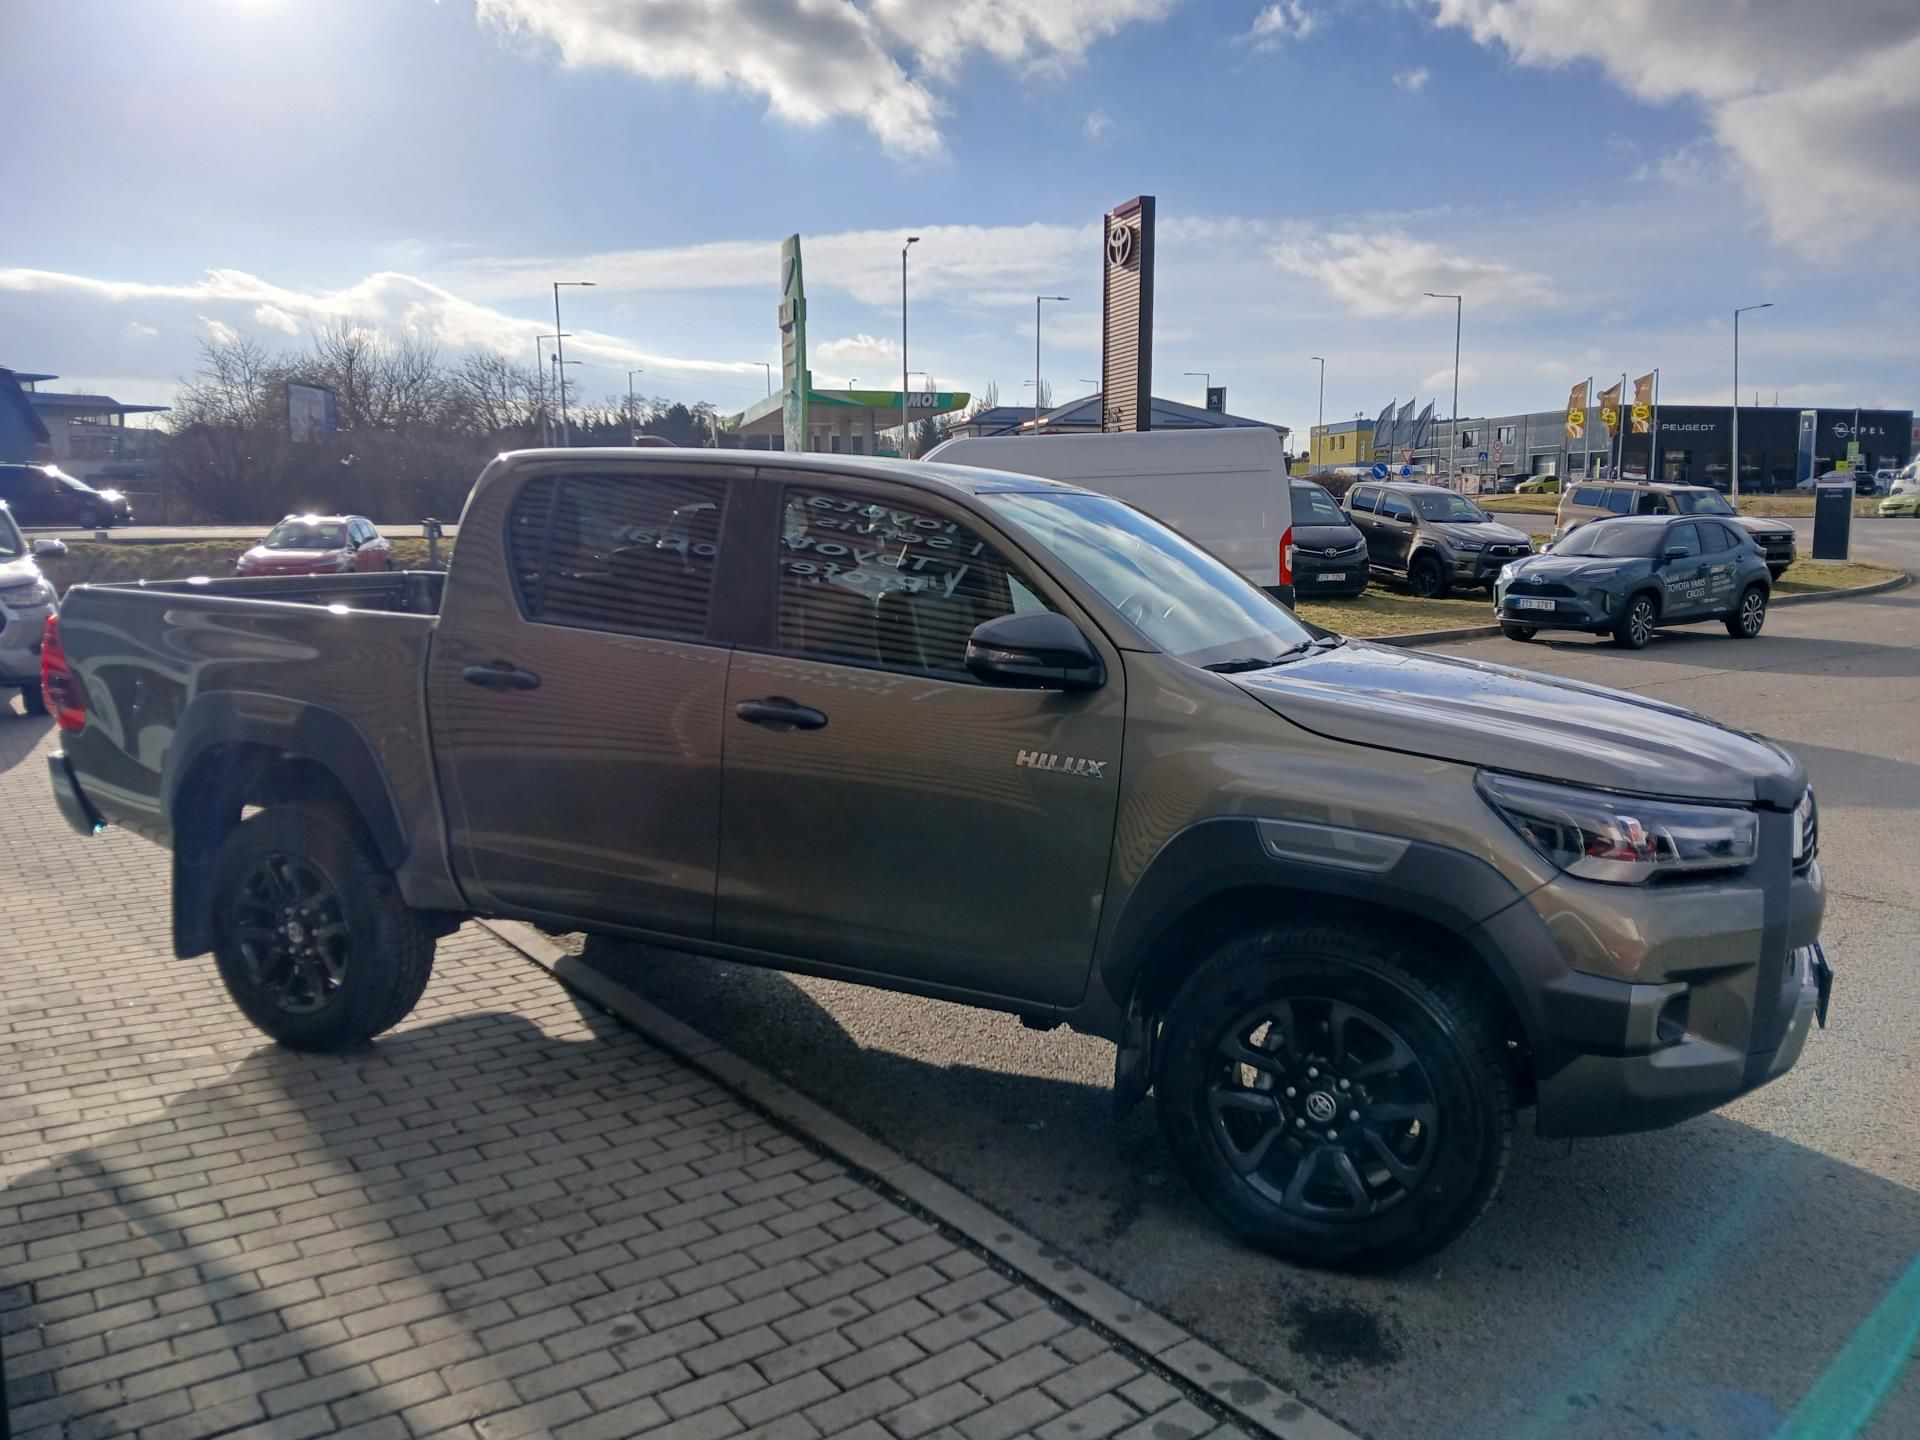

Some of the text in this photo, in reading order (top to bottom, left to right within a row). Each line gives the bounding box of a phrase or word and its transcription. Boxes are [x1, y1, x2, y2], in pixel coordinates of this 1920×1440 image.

[907, 393, 939, 408] MOL
[1662, 423, 1716, 431] PEUGEOT
[1850, 426, 1885, 435] OPEL
[1668, 578, 1706, 593] TOYOTA YARIS
[1686, 588, 1705, 599] CROSS
[1015, 749, 1107, 779] HILUX
